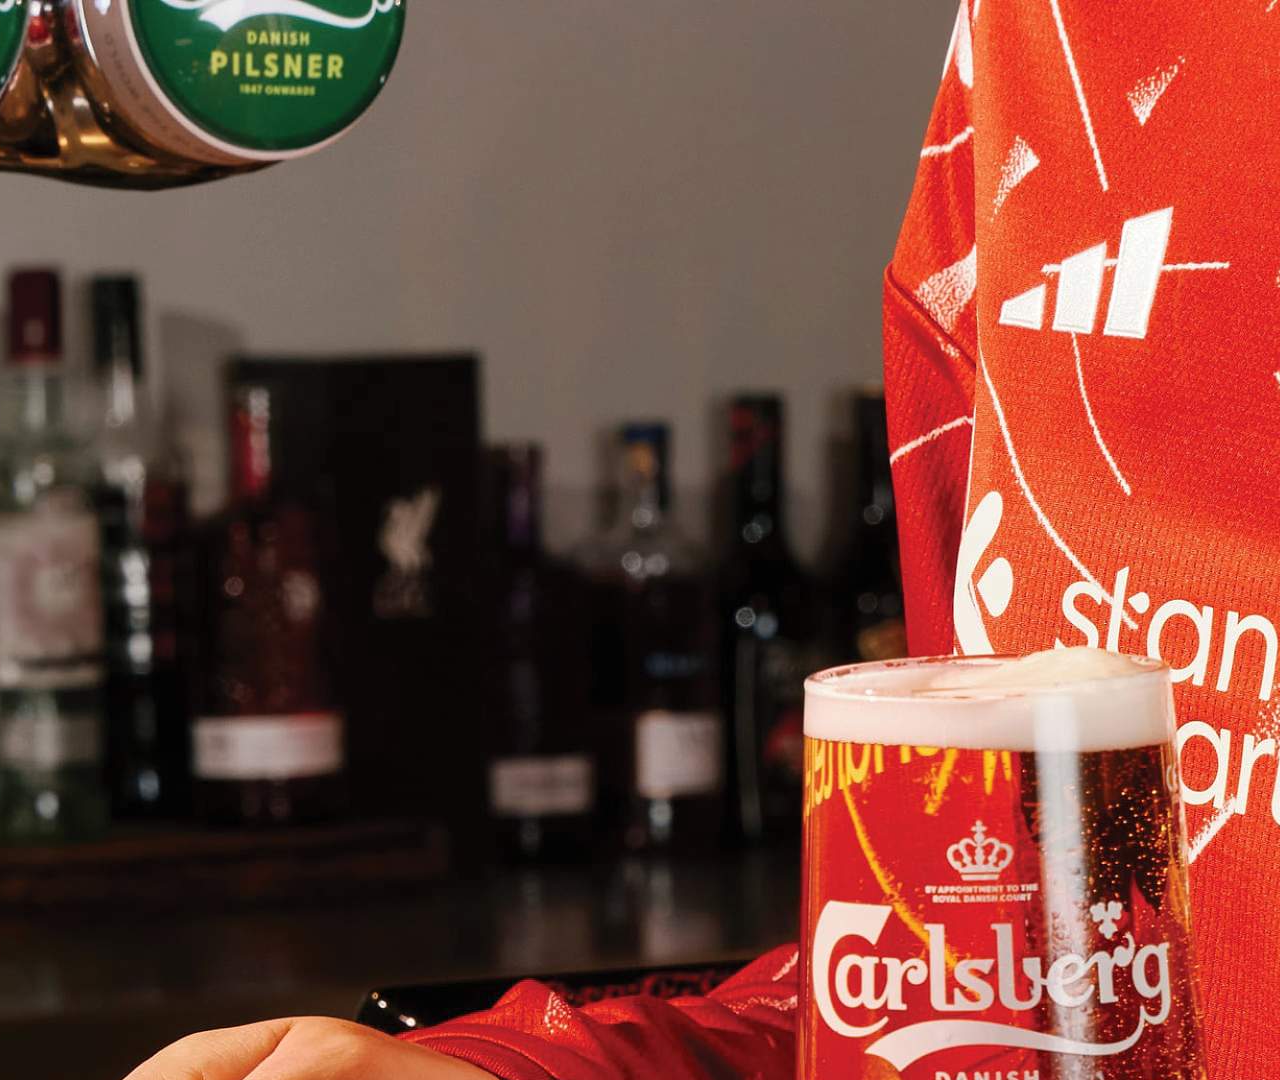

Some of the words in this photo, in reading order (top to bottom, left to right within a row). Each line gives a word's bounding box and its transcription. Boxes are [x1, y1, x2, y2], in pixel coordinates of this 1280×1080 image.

[246, 30, 310, 46] DANISH
[210, 51, 344, 79] PILSNER
[240, 84, 263, 95] 1847
[265, 85, 316, 97] ONWARDS
[1007, 884, 1019, 893] TO
[1021, 883, 1039, 892] THE
[812, 899, 1172, 1040] Carlsberg
